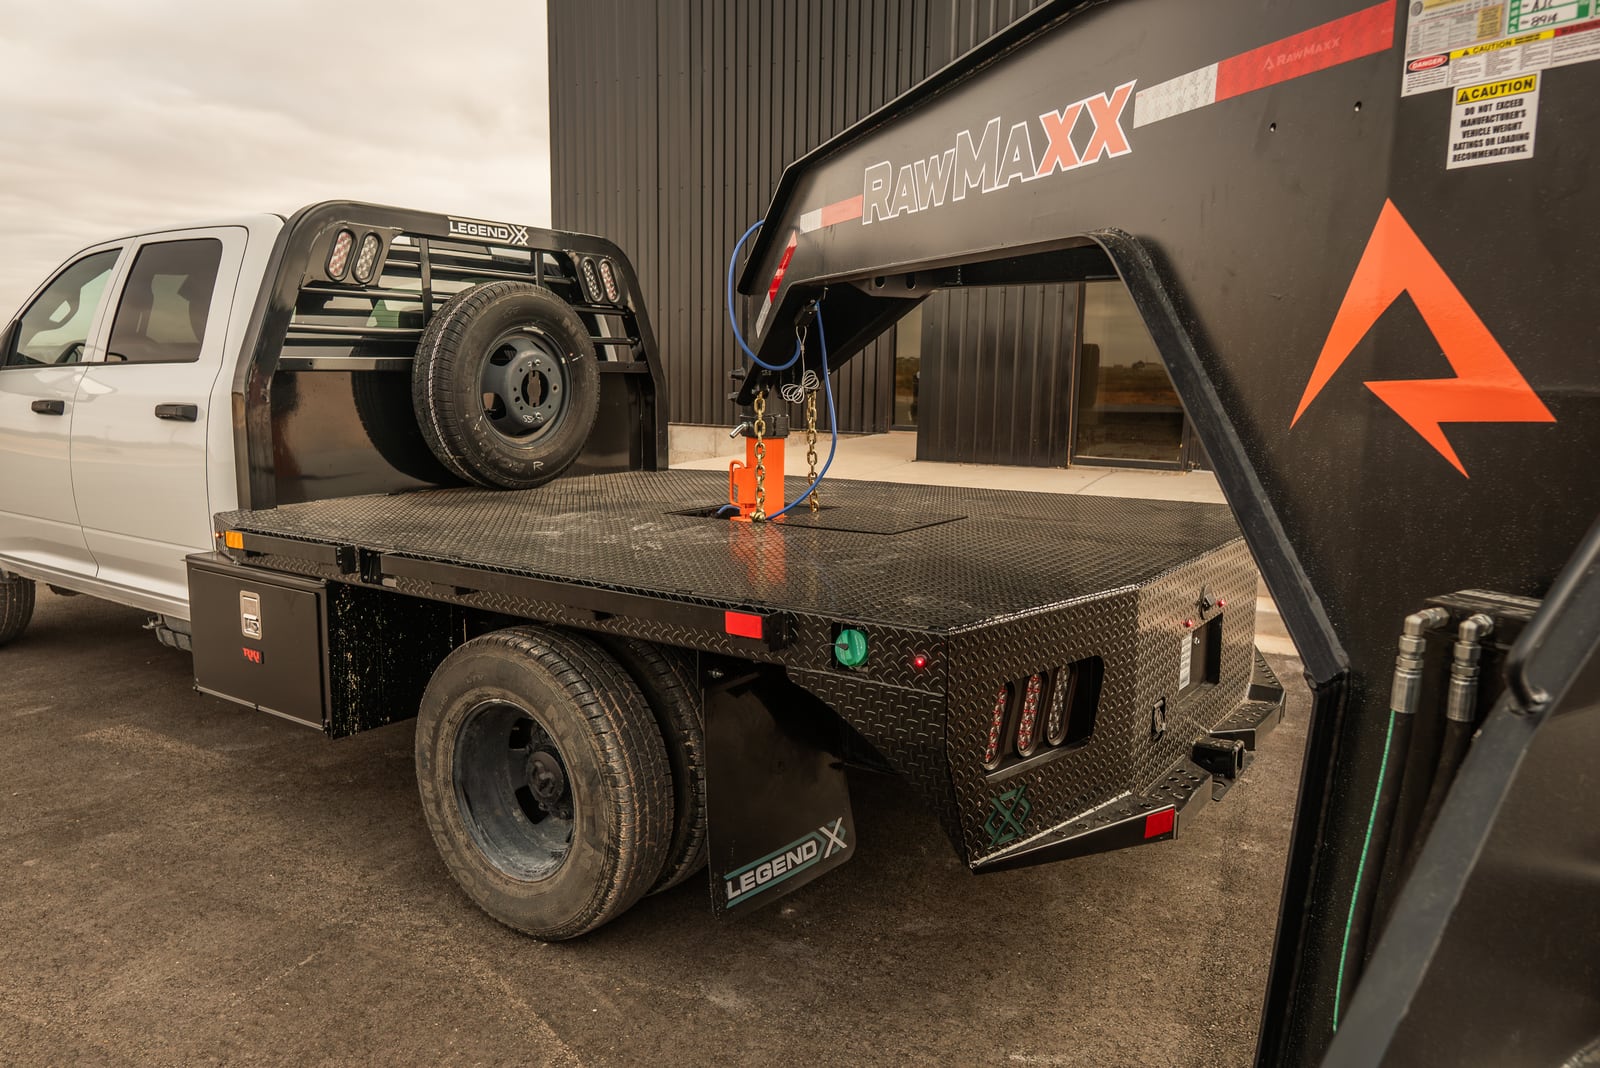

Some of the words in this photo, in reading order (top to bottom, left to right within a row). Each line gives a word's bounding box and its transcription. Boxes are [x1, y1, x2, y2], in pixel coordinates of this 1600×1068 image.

[1472, 39, 1513, 54] CAUTION
[1411, 57, 1444, 69] DANGER
[1471, 78, 1533, 99] CAUTION
[1464, 106, 1475, 116] DO
[1478, 103, 1493, 113] NOT
[1495, 98, 1524, 110] EXCEED
[1460, 109, 1526, 127] MANUFACTURER'S
[1462, 126, 1491, 139] VEHICLE
[1492, 121, 1523, 134] WEIGHT
[1452, 139, 1484, 151] RATINGS
[1485, 137, 1496, 147] OR
[1497, 132, 1530, 145] LOADING
